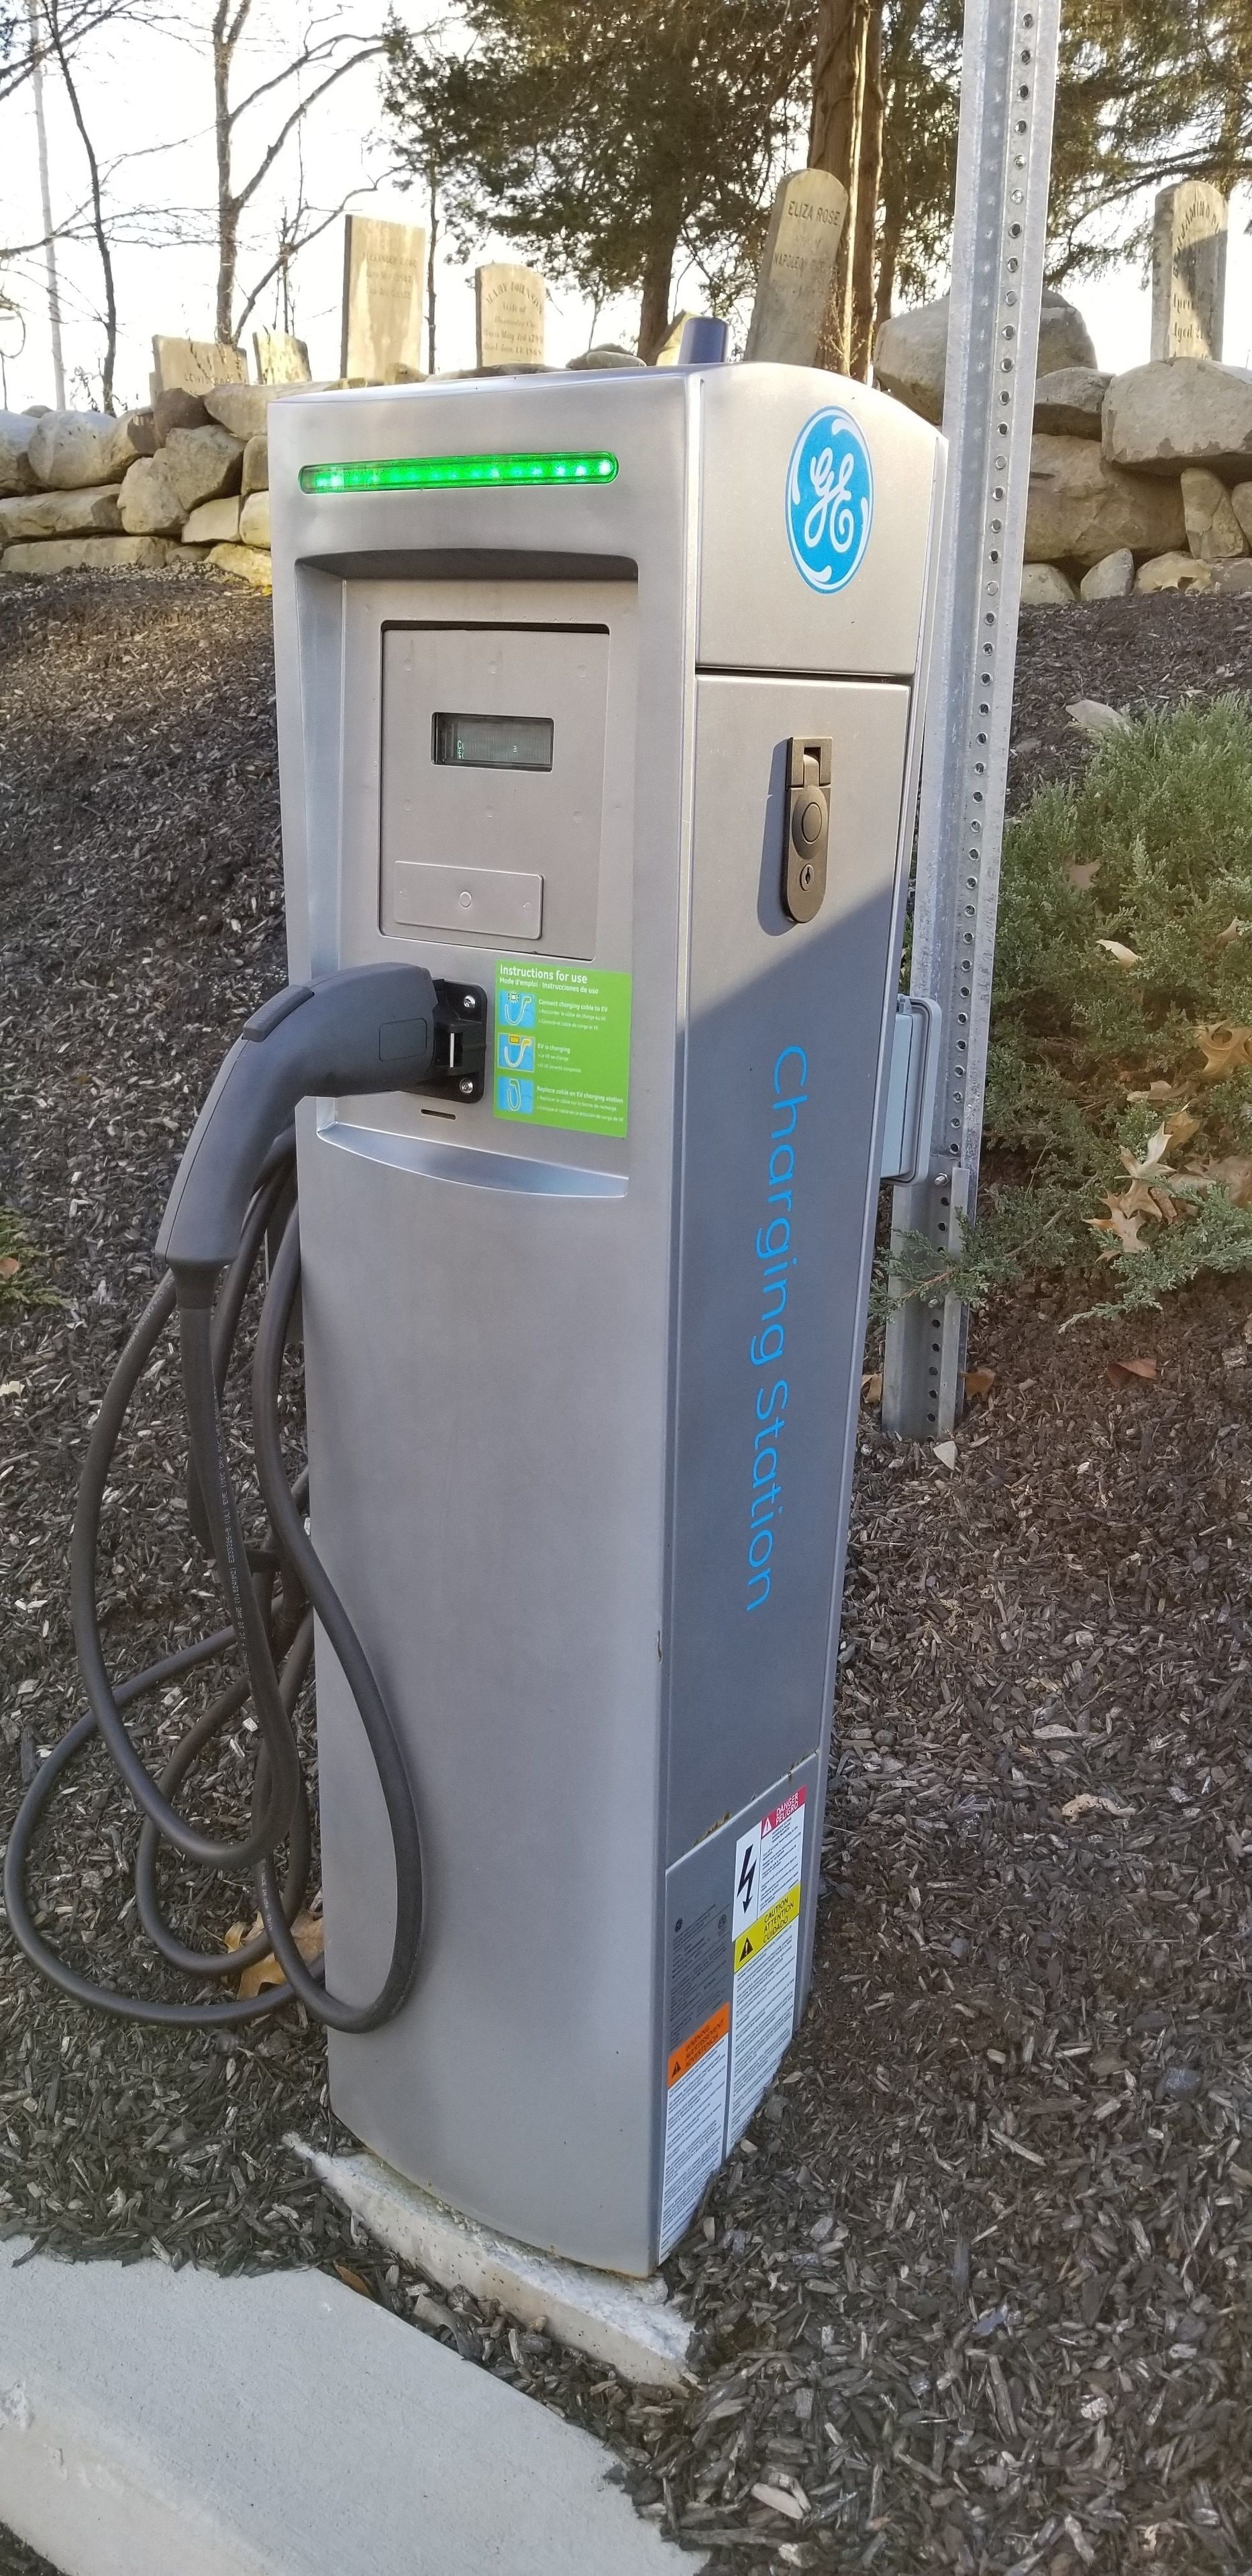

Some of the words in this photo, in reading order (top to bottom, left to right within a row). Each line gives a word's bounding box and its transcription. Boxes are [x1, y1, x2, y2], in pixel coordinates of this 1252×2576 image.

[788, 201, 813, 221] ELIZA
[816, 207, 841, 226] ROSE
[485, 282, 507, 305] MARY
[499, 977, 514, 985] Mode
[515, 977, 538, 988] d'emploi
[542, 981, 580, 993] Instrucciones
[500, 964, 554, 980] Instructions
[556, 970, 569, 982] for
[571, 974, 588, 984] use
[538, 999, 558, 1007] Connect
[559, 1001, 580, 1010] charging
[580, 1004, 594, 1012] cable
[550, 1044, 570, 1055] charging
[537, 1085, 556, 1094] Replace
[584, 1091, 605, 1102] charging
[749, 1045, 808, 1366] Charging
[221, 1491, 229, 1505] EVE
[747, 1379, 789, 1611] Station
[223, 1509, 231, 1524] (UL)
[776, 1792, 798, 1817] DANGER
[776, 1801, 798, 1825] PELIGRO
[764, 1896, 788, 1923] CAUTION
[764, 1900, 794, 1933] ATTENTION
[763, 1916, 788, 1943] CUIDADO
